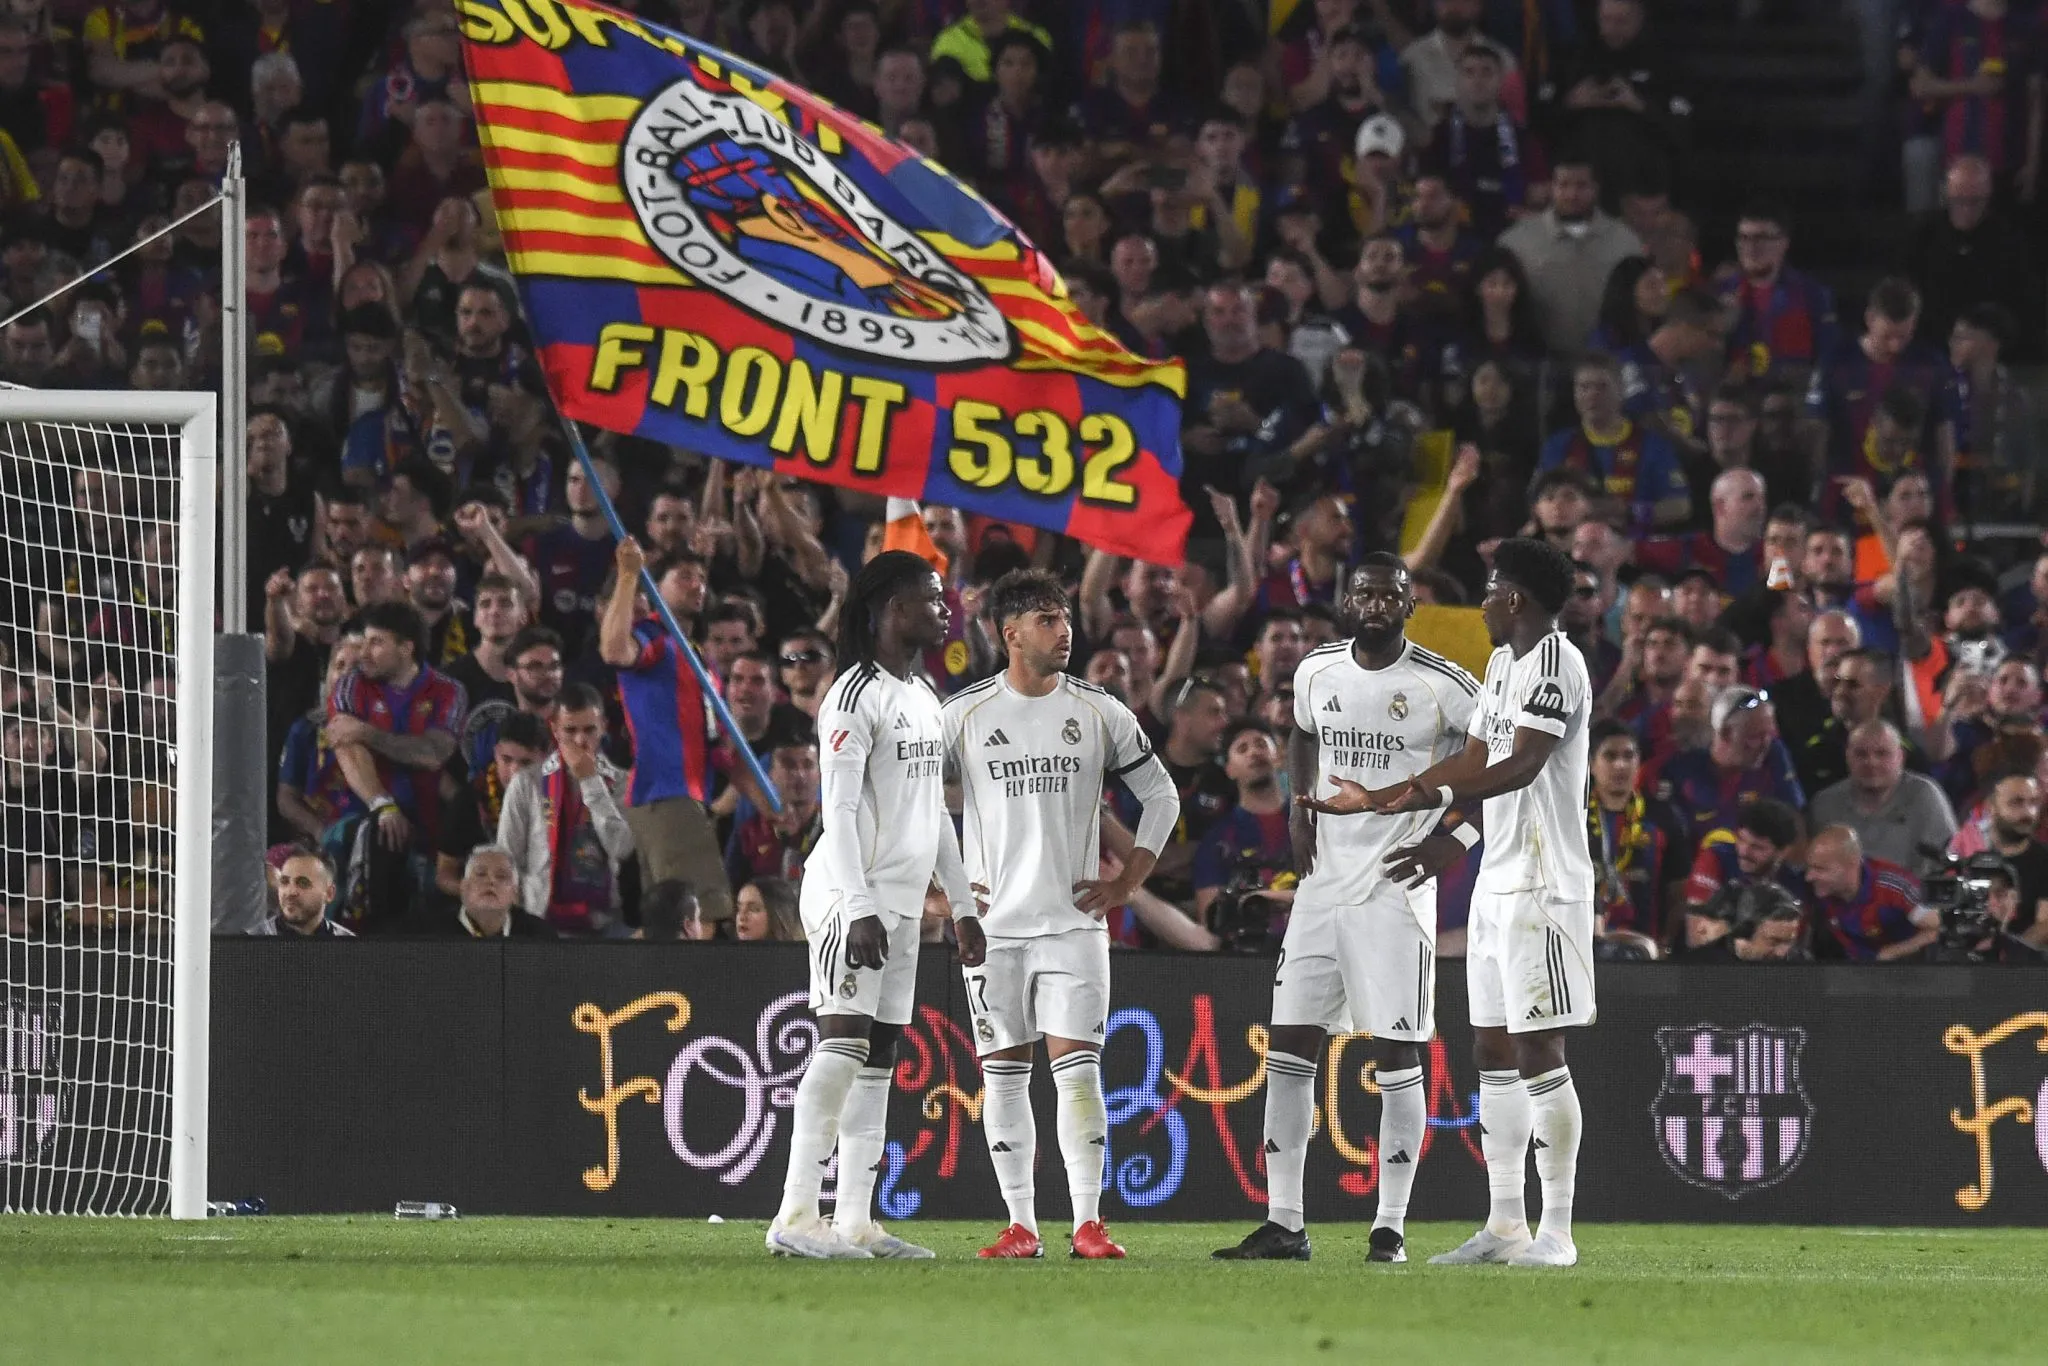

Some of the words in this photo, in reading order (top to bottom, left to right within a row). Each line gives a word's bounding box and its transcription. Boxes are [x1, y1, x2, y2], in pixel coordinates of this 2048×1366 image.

[636, 93, 746, 286] FOOT-BALL
[799, 303, 915, 349] 1899
[590, 322, 907, 473] FRONT
[948, 400, 1137, 503] 532
[1321, 725, 1405, 752] Emirates
[987, 753, 1080, 781] Emirates
[1333, 750, 1349, 766] FLY
[1350, 752, 1390, 770] BETTER
[1005, 780, 1025, 798] FLY
[1028, 778, 1069, 795] BETTER
[965, 974, 989, 1013] 17
